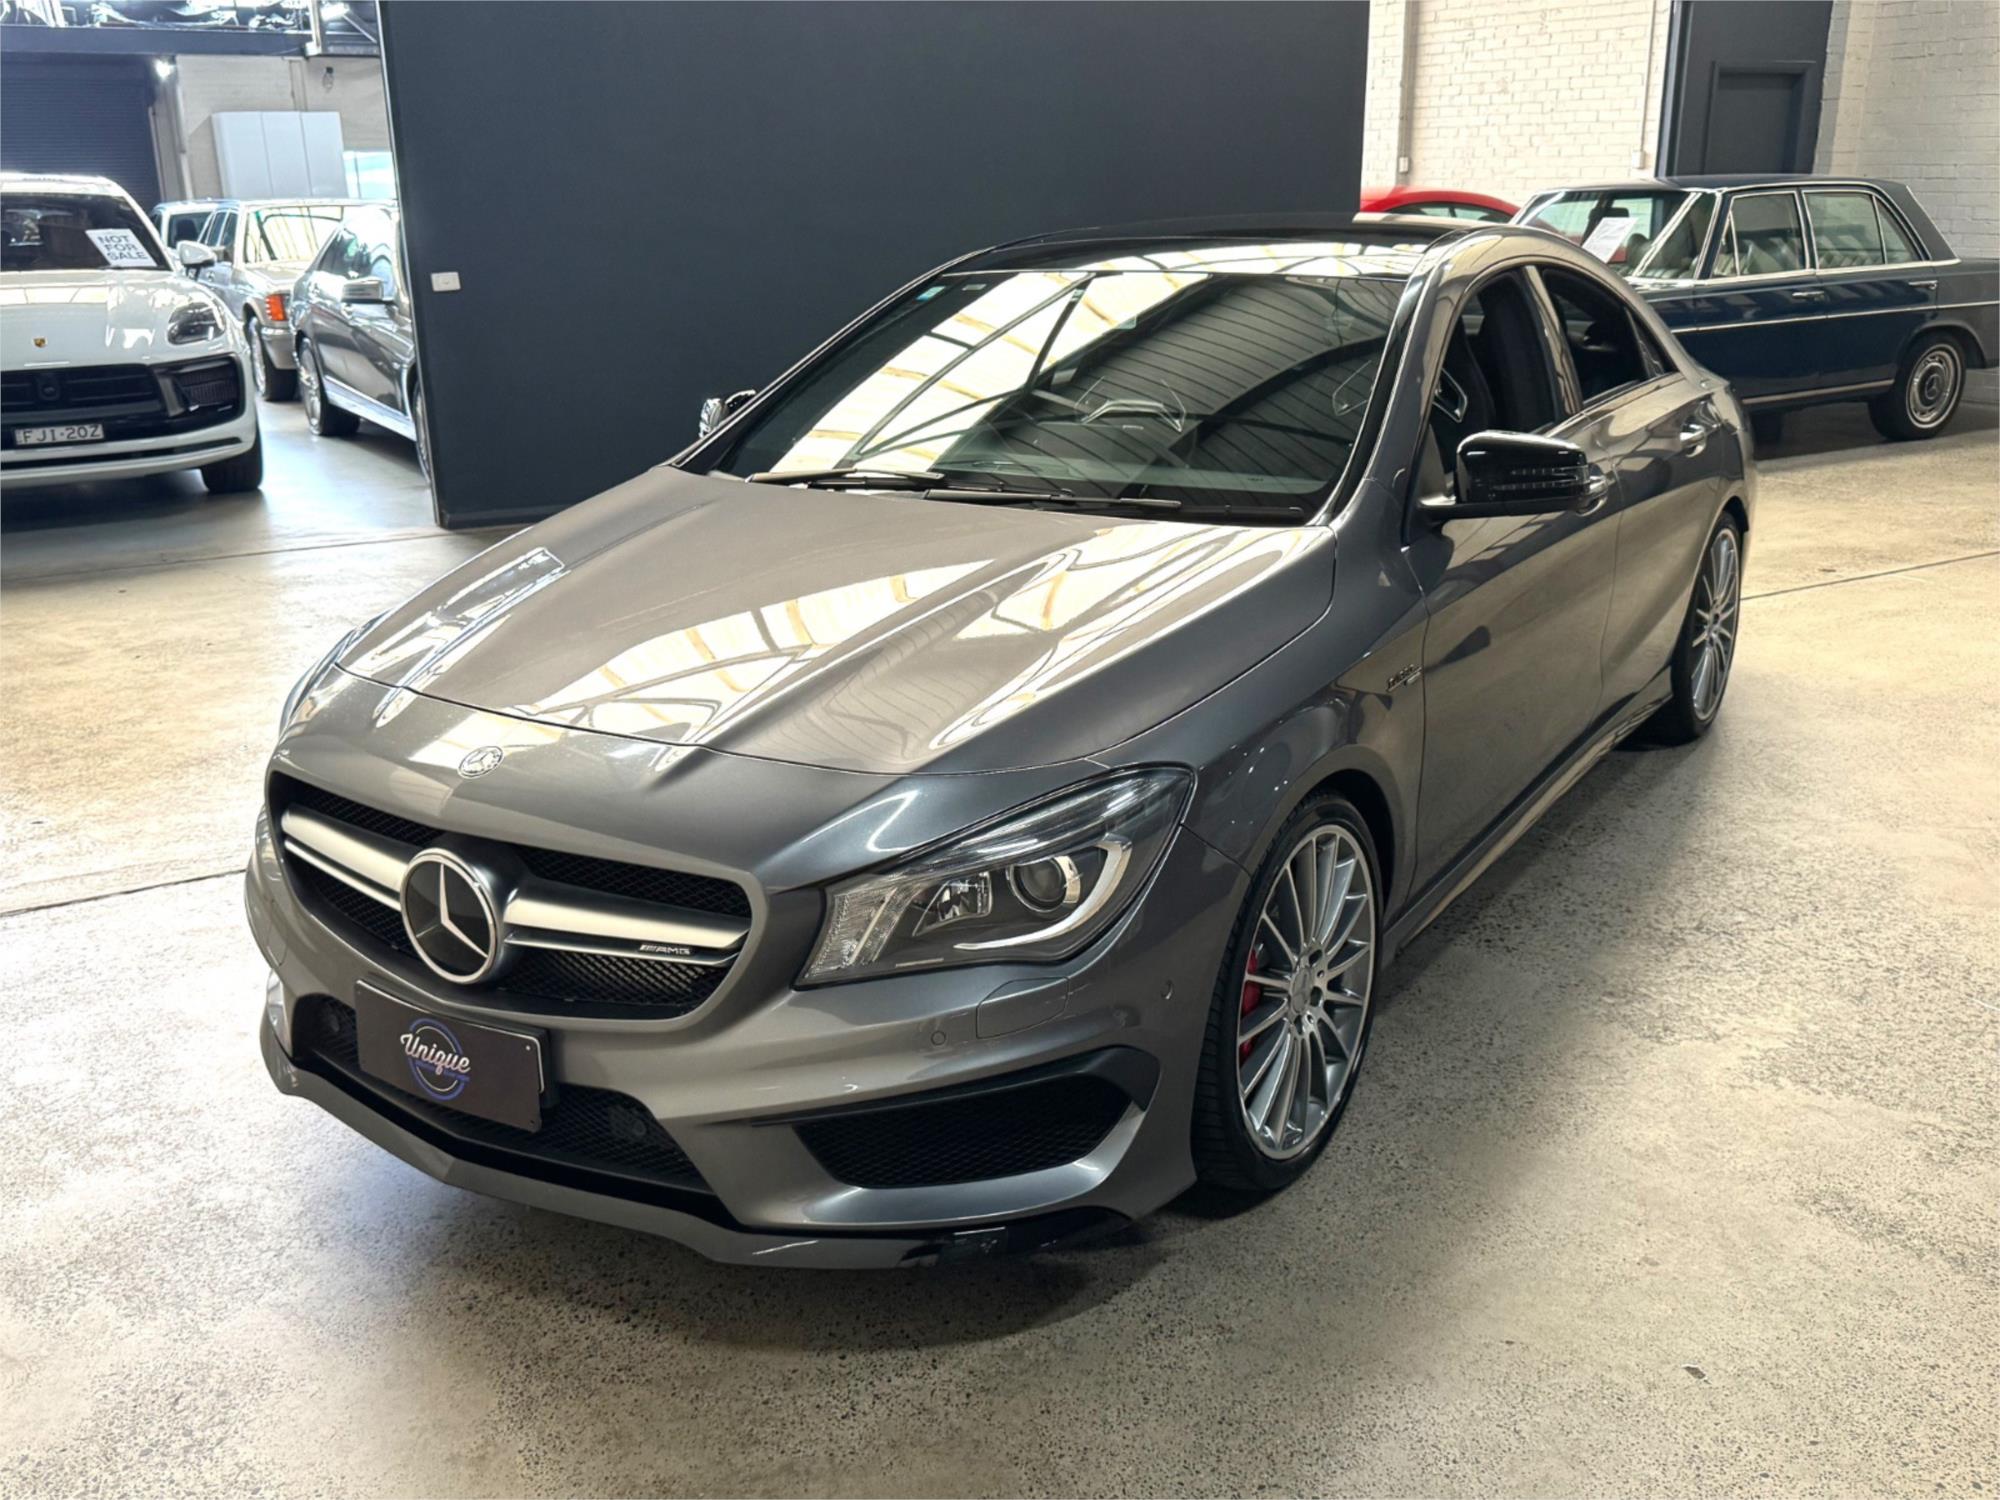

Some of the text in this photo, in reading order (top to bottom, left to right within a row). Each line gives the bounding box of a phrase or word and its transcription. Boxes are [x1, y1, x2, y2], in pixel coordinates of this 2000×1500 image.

[97, 235, 129, 243] NOT
[104, 243, 138, 251] FOR
[107, 251, 149, 260] SALE
[400, 1033, 471, 1075] Unique
